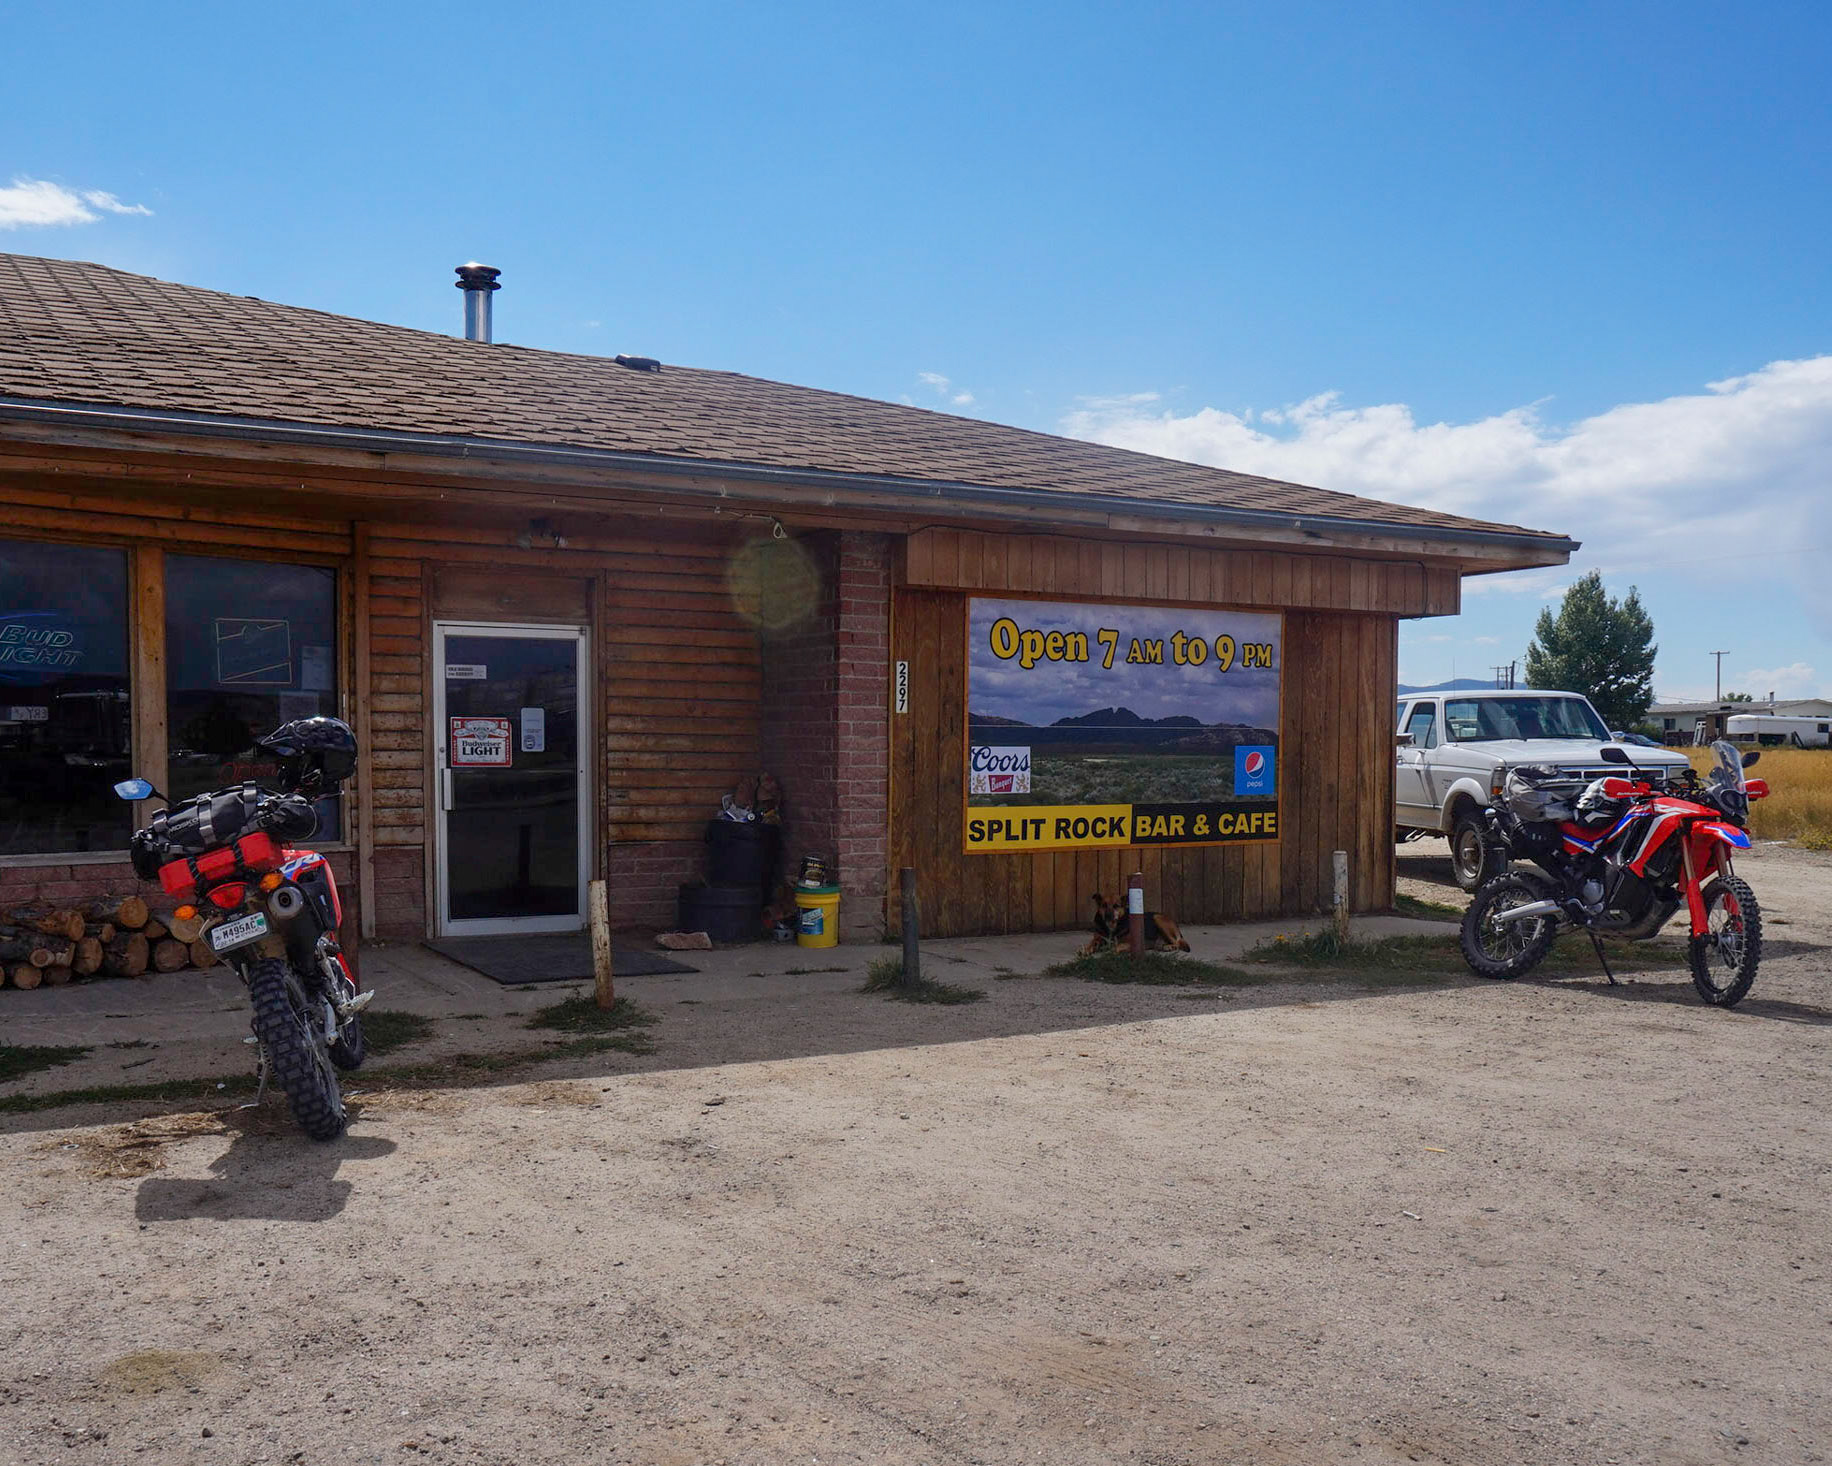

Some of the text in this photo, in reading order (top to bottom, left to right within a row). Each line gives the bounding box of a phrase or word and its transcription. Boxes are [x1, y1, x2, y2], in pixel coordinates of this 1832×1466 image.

[0, 624, 73, 648] BUD
[991, 617, 1272, 672] Open 7 AM to 9 PM
[0, 646, 85, 665] IGHT
[899, 663, 907, 711] 2297
[462, 747, 501, 756] LIGHT
[971, 746, 1030, 772] Coors
[1246, 780, 1264, 788] pepsi
[968, 812, 1277, 842] SPLIT ROCK BAR & CAFE
